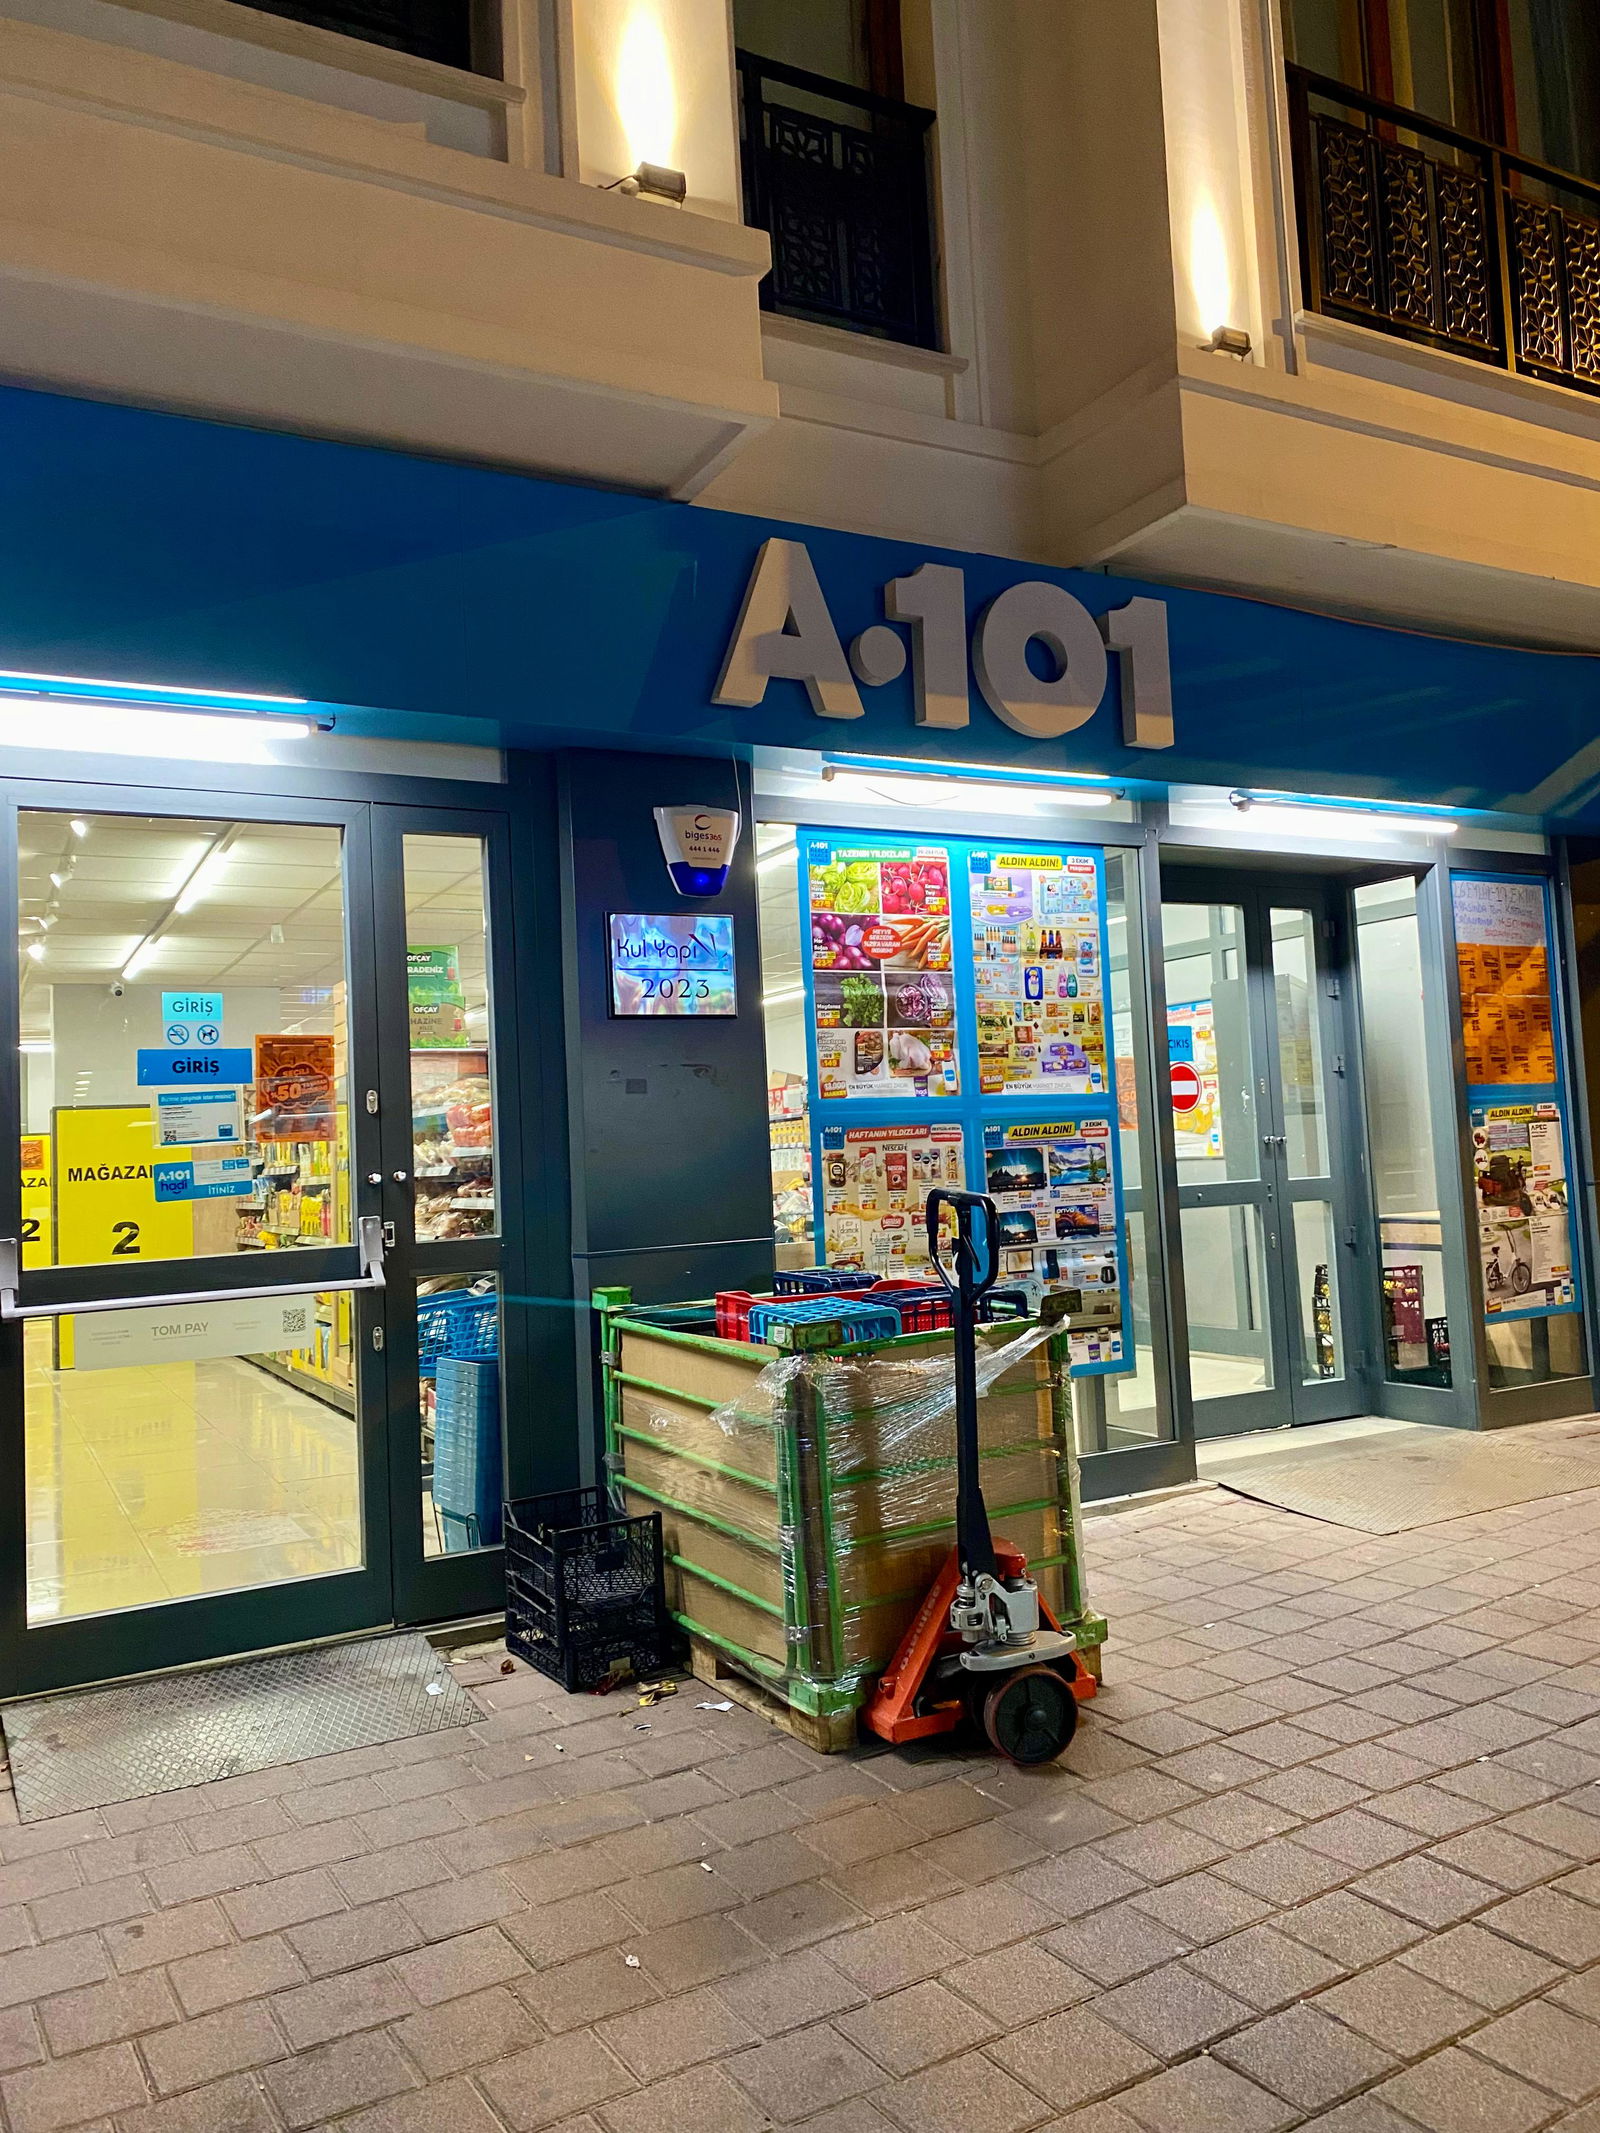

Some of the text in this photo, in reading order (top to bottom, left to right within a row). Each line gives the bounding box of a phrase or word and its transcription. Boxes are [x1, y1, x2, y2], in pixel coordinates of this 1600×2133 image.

[685, 830, 722, 841] biges365
[999, 856, 1059, 868] ALDIN ALDIN!
[617, 938, 647, 958] Kul
[406, 954, 431, 963] OFÇAY
[641, 978, 710, 999] 2023
[172, 997, 213, 1016] GİRİŞ
[413, 1006, 439, 1014] OFÇAY
[172, 1056, 220, 1077] GİRİŞ
[1490, 1107, 1532, 1118] ALDIN ALDIN!
[848, 1130, 887, 1139] HAFTANIN
[887, 1127, 928, 1137] YILDIZLARI
[1012, 1125, 1072, 1137] ALDIN ALDIN!
[68, 1163, 153, 1182] MAĞAZA
[160, 1181, 188, 1193] hadi
[22, 1218, 41, 1242] 2
[111, 1221, 141, 1255] 2
[151, 1321, 209, 1337] TOM PAY
